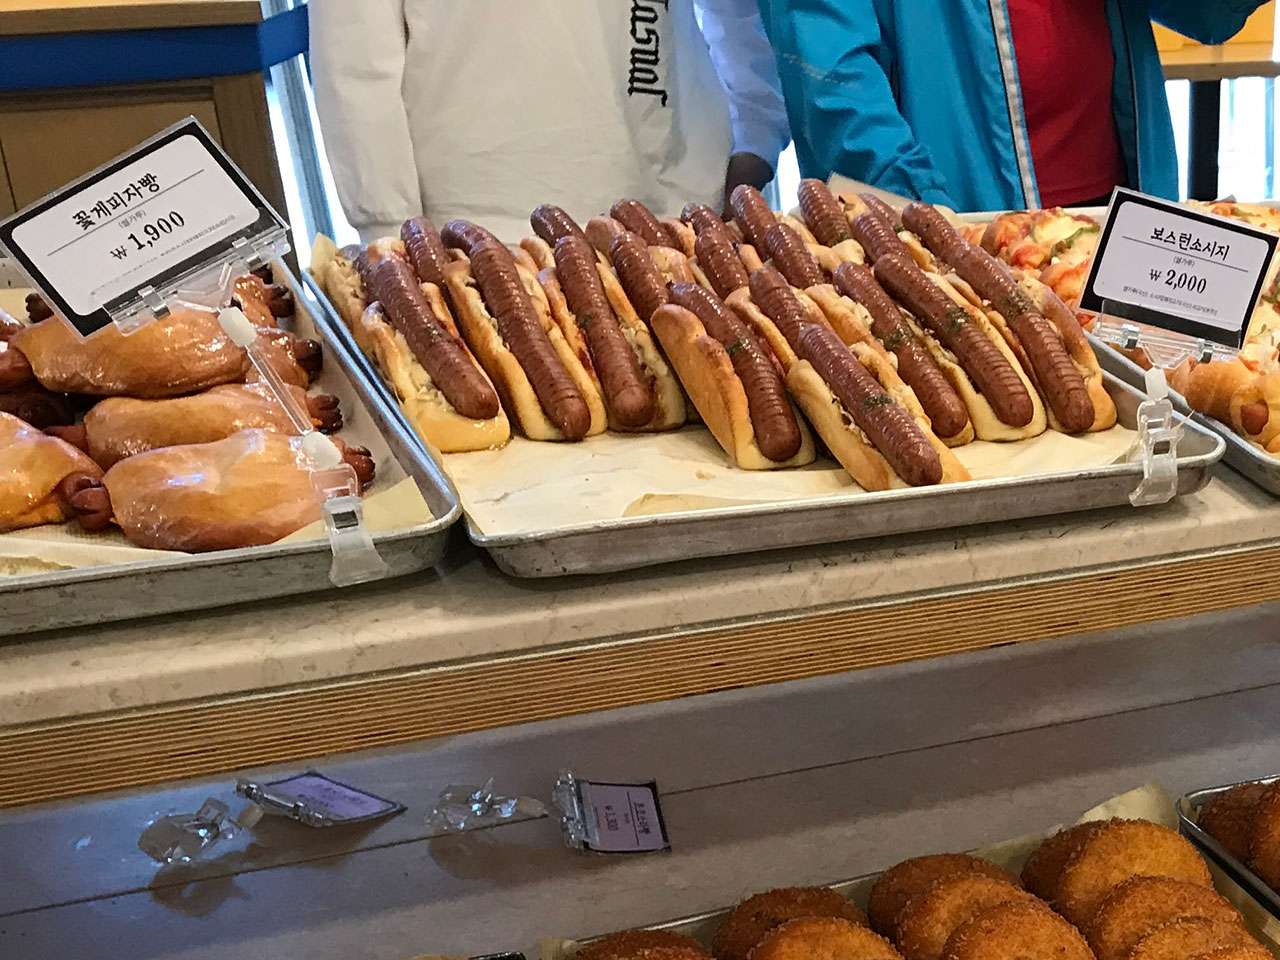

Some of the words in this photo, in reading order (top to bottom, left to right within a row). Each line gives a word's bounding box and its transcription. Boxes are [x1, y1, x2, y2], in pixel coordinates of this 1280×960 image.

[72, 172, 160, 231] 꽃게피자빵
[127, 210, 186, 251] 1,900
[1150, 226, 1230, 261] 보스턴소시지
[1164, 269, 1207, 294] 2,000
